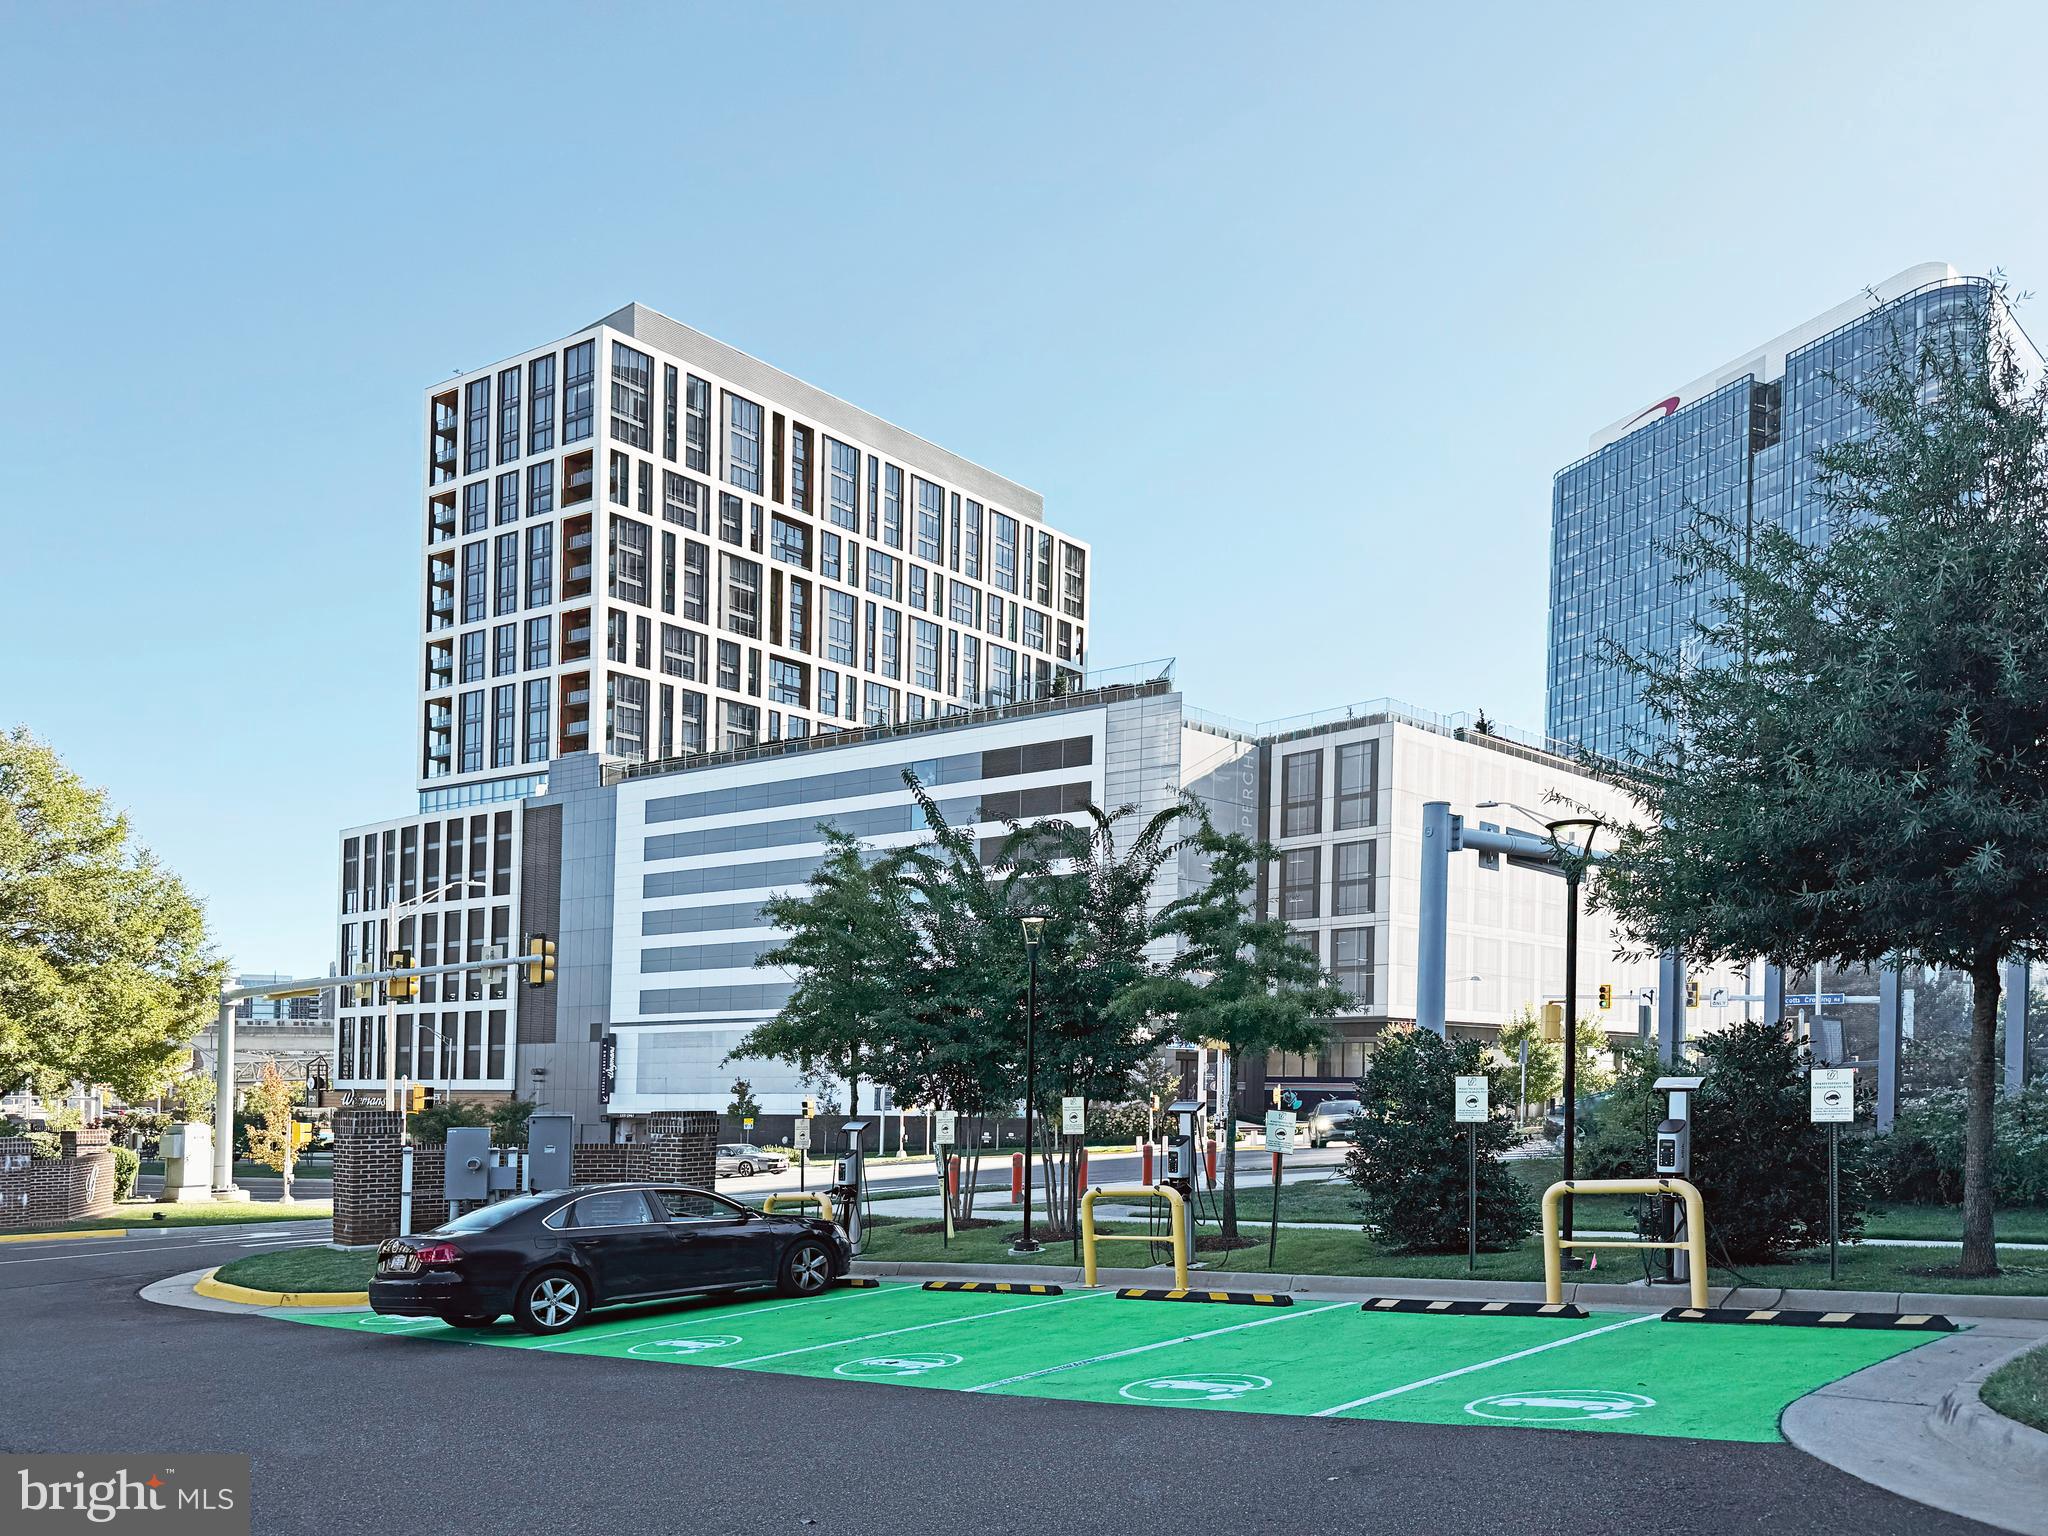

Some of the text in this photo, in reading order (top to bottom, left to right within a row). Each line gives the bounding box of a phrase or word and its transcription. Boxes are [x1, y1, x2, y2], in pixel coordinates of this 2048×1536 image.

[1241, 755, 1255, 827] PERCH
[1804, 996, 1832, 1004] Croing
[605, 1046, 617, 1080] Wegmans
